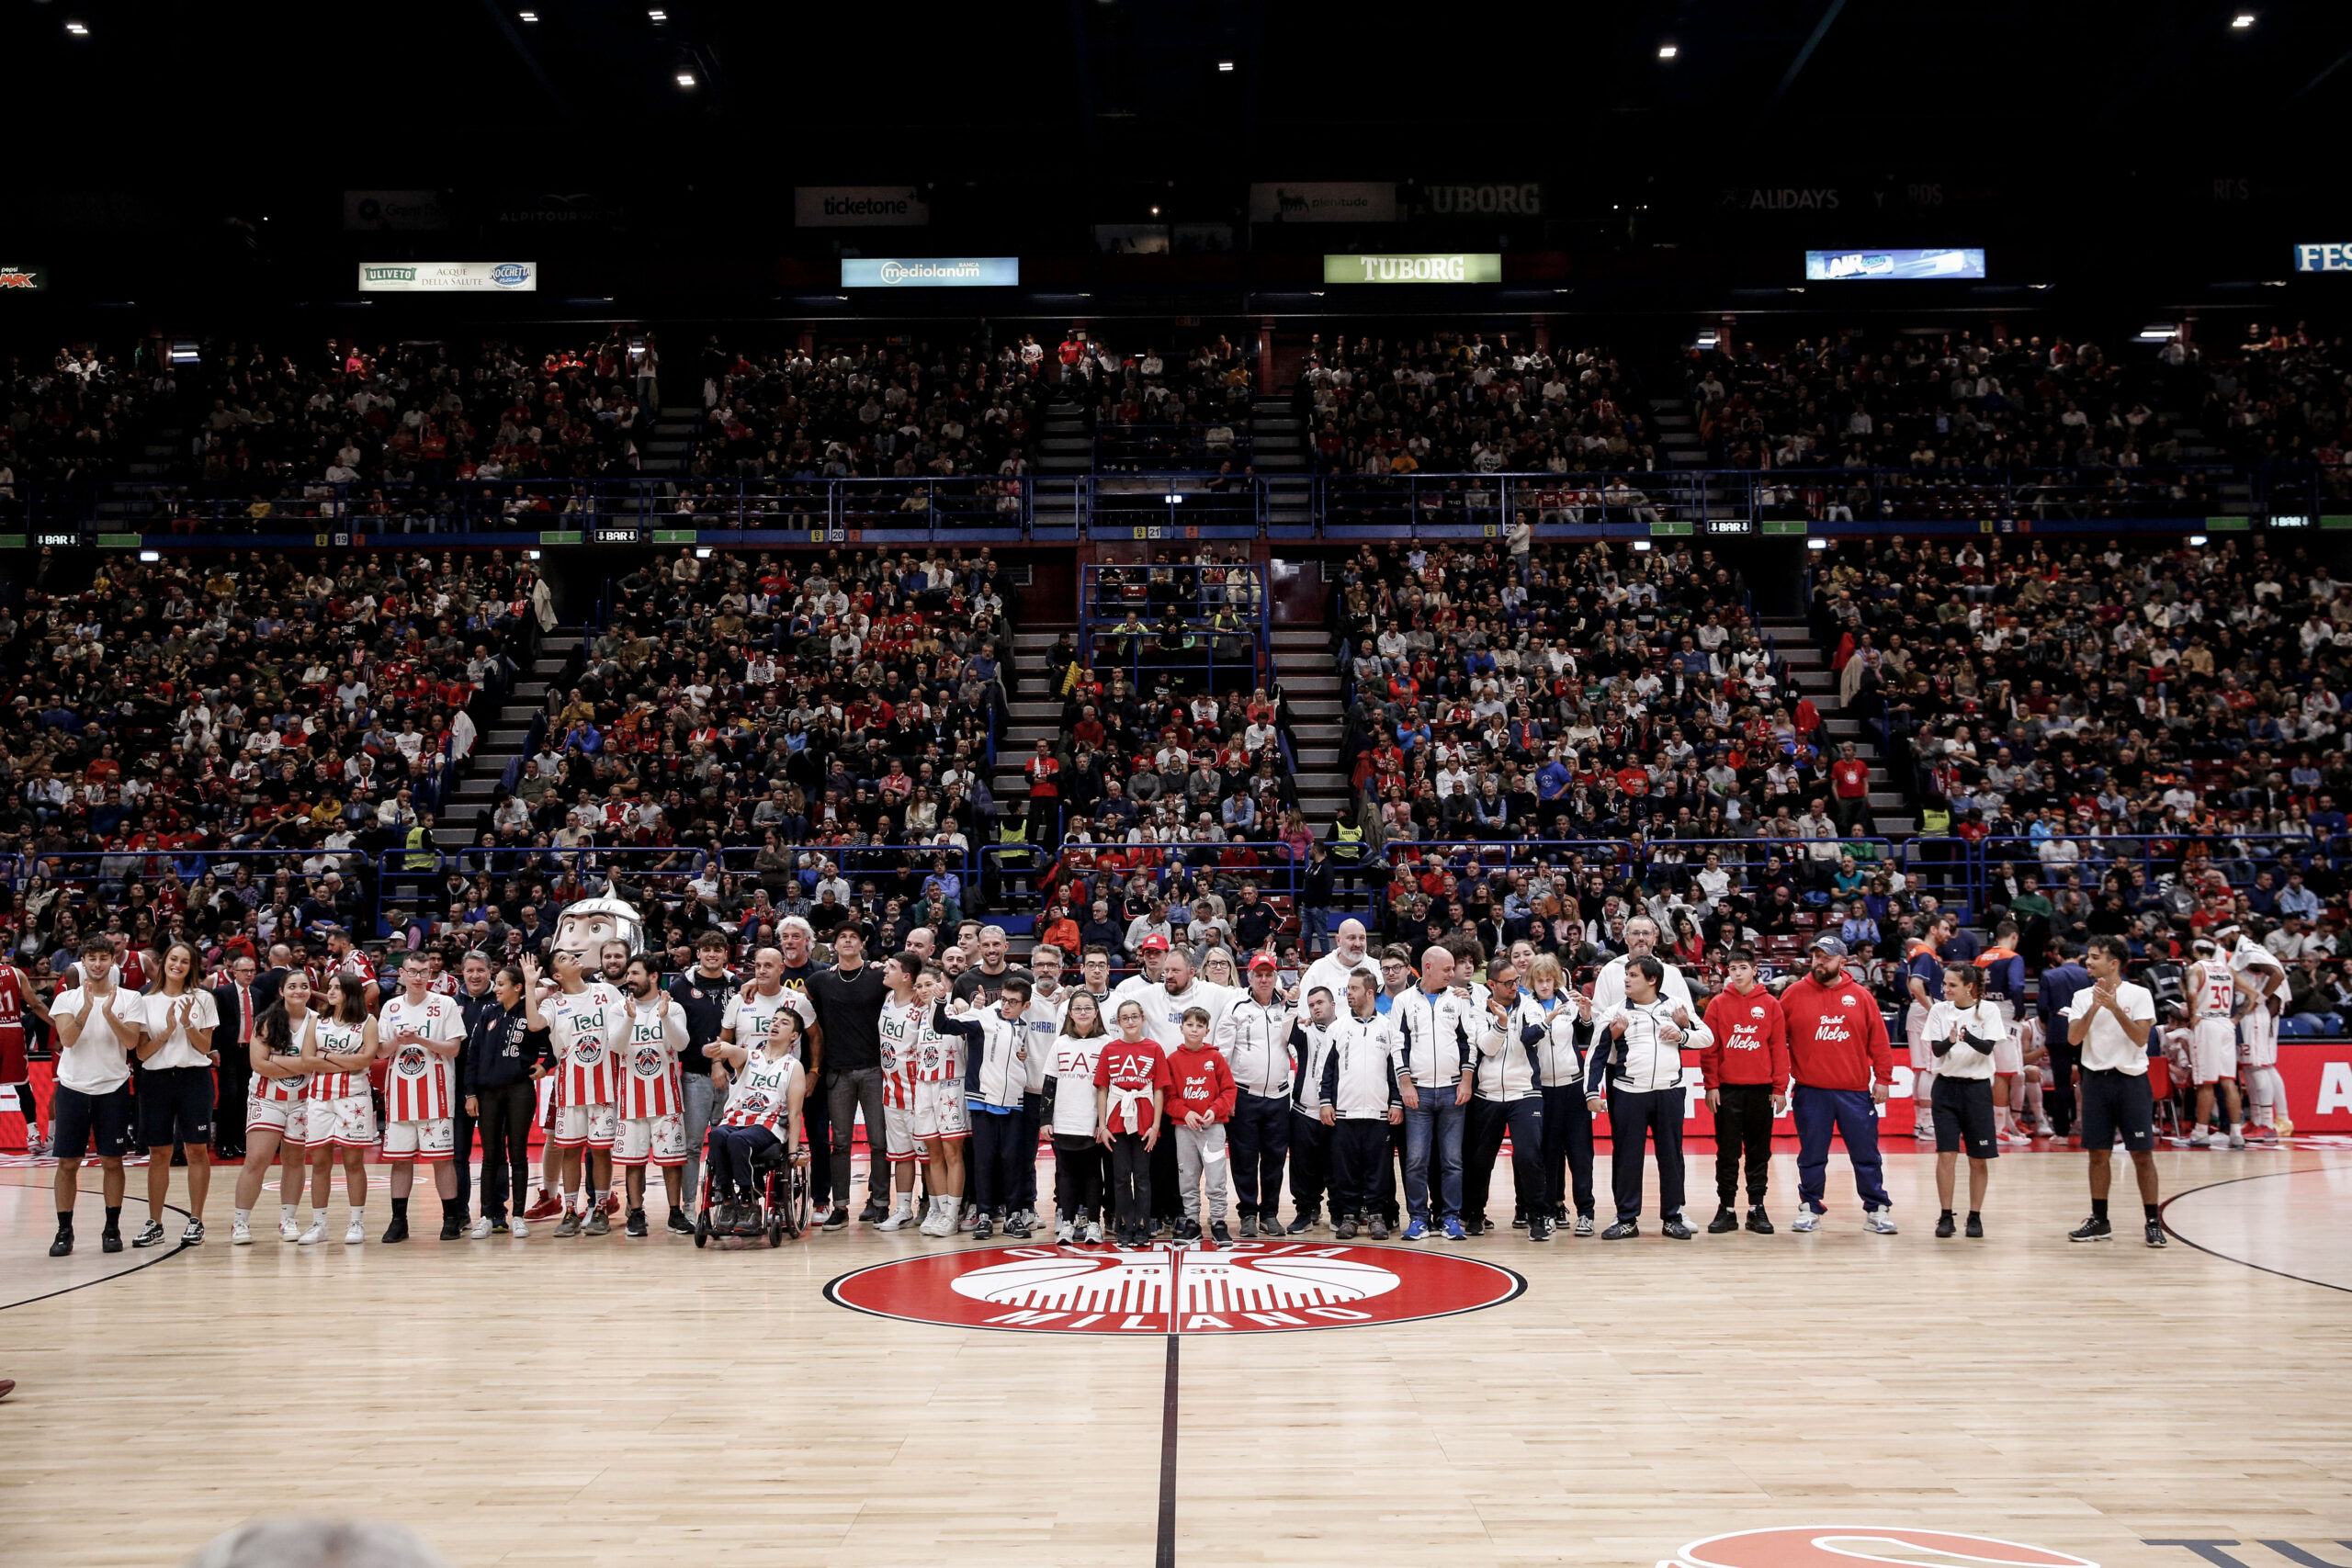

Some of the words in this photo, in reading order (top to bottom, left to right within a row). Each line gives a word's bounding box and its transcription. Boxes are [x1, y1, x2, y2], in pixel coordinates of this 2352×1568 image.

[823, 197, 908, 215] ticketone
[1749, 189, 1840, 209] ALIDAYS
[369, 269, 413, 279] ULIVETO
[490, 266, 532, 279] ROCCHETTA
[884, 263, 980, 279] mediolanum
[1361, 256, 1464, 281] TUBORG
[1718, 522, 1742, 532] BAR
[2278, 516, 2301, 526] BAR
[44, 536, 69, 545] BAR
[336, 536, 347, 544] 19
[606, 532, 628, 541] BAR
[832, 531, 843, 539] 20
[594, 993, 608, 1005] 24
[2210, 986, 2231, 1009] 30
[426, 1005, 441, 1017] 35
[783, 1000, 797, 1010] 47
[568, 1007, 604, 1032] Ted
[906, 1007, 921, 1021] 33
[1819, 1014, 1846, 1025] Basket
[350, 1024, 362, 1033] 42
[633, 1020, 663, 1042] Ted
[881, 1015, 907, 1039] Ted
[1733, 1024, 1758, 1034] Basket
[1815, 1025, 1850, 1043] Melzo
[322, 1033, 351, 1049] Ted
[1726, 1034, 1761, 1052] Melzo
[1107, 1054, 1155, 1077] EA7
[752, 1070, 782, 1089] Ted
[1186, 1076, 1207, 1086] Basket
[1182, 1086, 1210, 1100] Melzo
[981, 1305, 1374, 1330] MILANO
